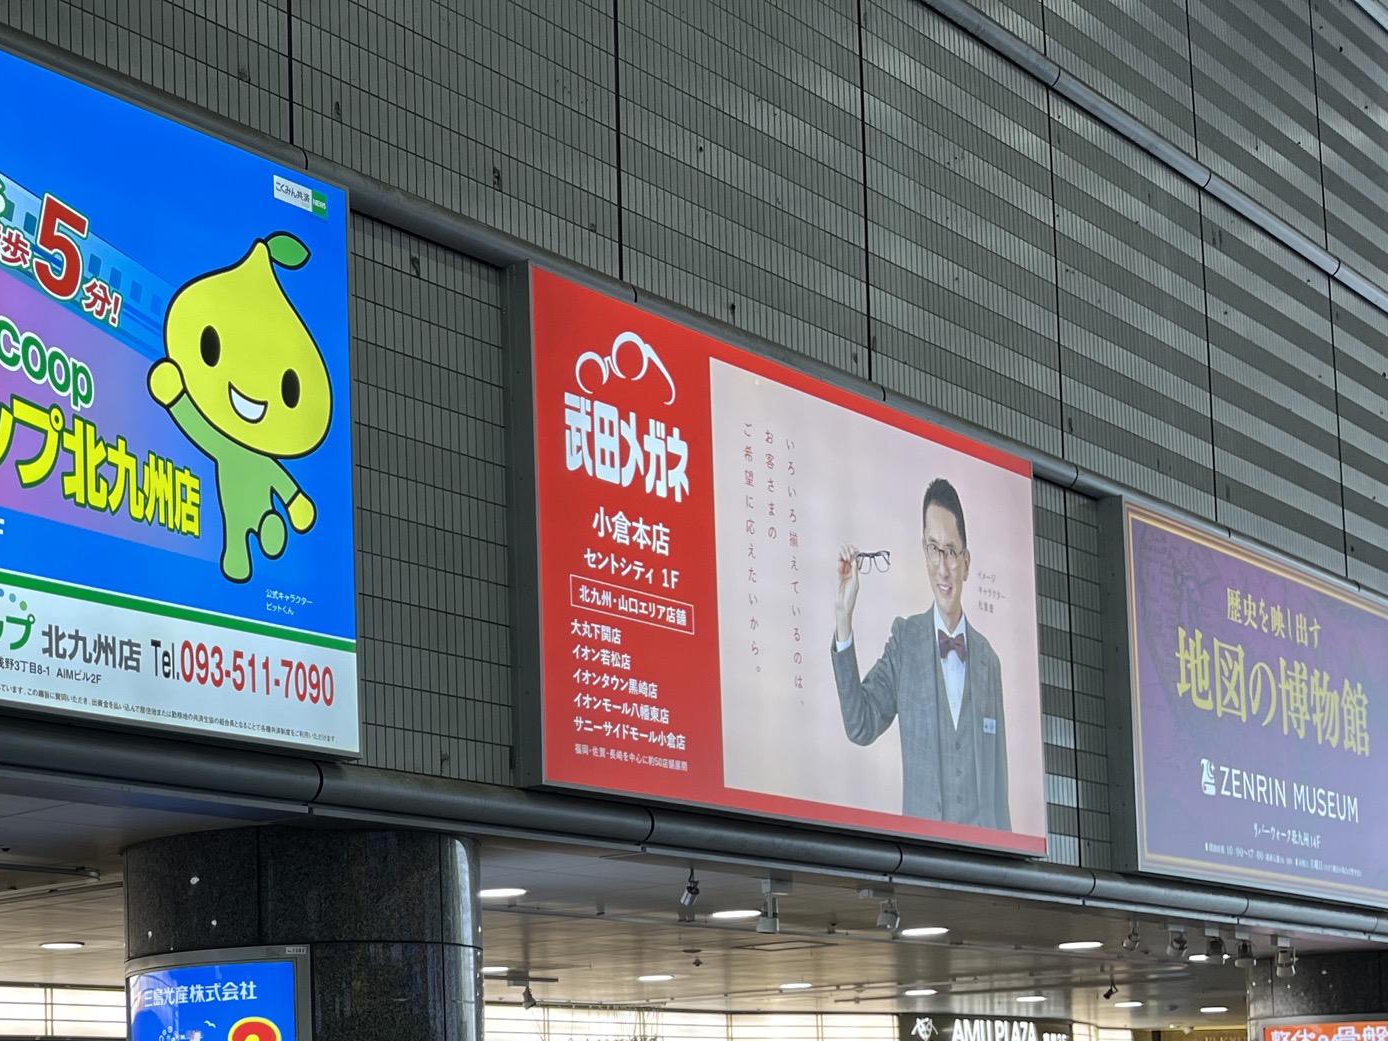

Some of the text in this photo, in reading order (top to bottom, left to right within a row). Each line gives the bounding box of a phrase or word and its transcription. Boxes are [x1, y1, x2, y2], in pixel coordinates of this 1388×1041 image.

[312, 198, 327, 210] NEWS
[564, 391, 690, 503] 武田メガネ
[764, 430, 778, 540] お客さまの
[592, 506, 670, 556] 小倉本店
[584, 548, 680, 589] セントシティ 1F
[579, 584, 687, 627] 北九州・山口エリア店舗
[1226, 587, 1321, 649] 歴史を映し出す
[42, 624, 141, 673] 北九州店
[570, 619, 622, 645] 大丸下関店
[56, 668, 102, 684] AIMビル2F
[572, 644, 631, 670] イオン若松店
[573, 668, 658, 699] イオンタウン黒崎店
[1175, 626, 1370, 758] 地図の博物館
[573, 692, 670, 725] イオンモール八幡東店
[573, 716, 686, 751] サニーサイドモール小倉店
[1220, 766, 1358, 823] ZENRIN MUSEUM
[144, 981, 257, 1008] 三島光産株式会社
